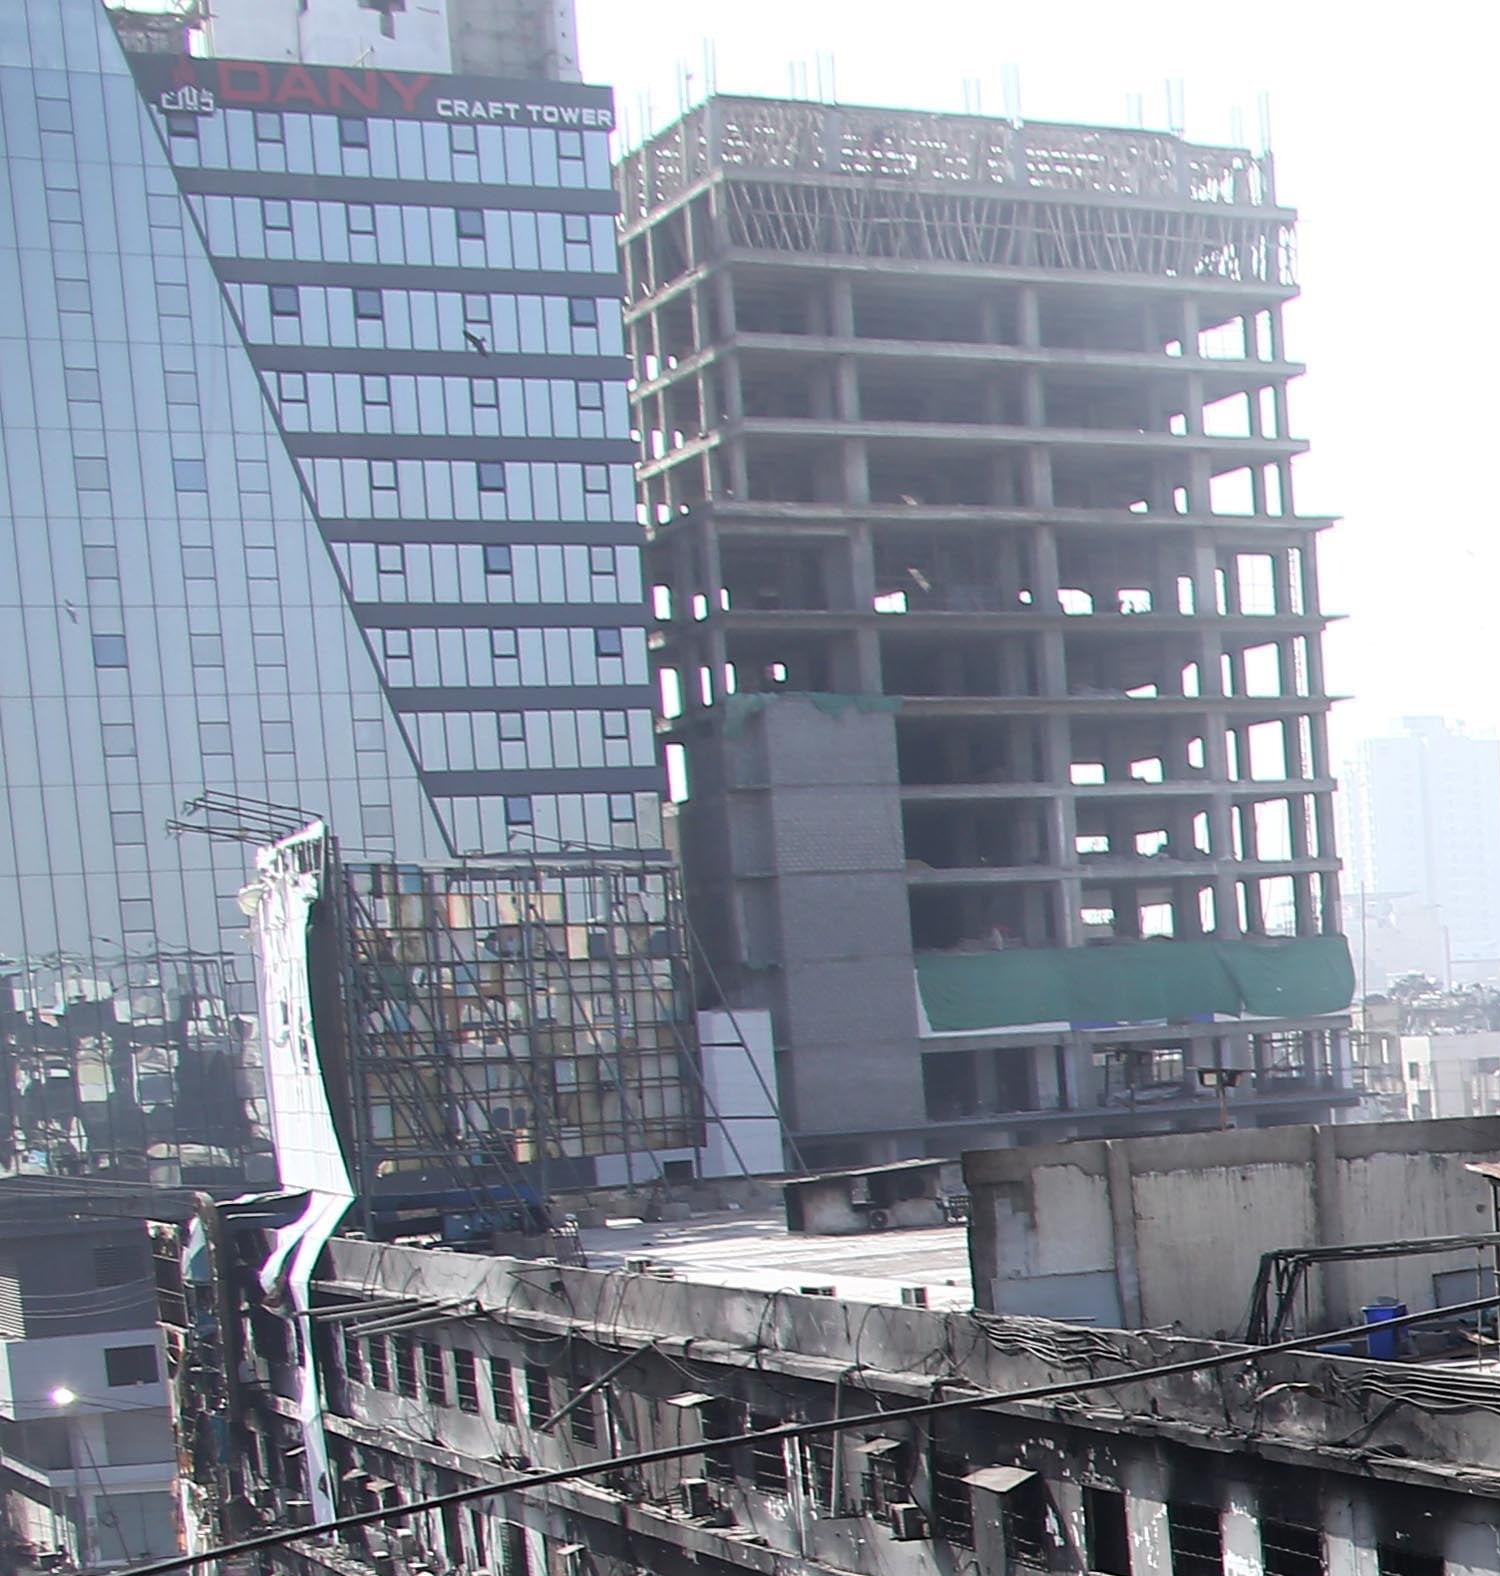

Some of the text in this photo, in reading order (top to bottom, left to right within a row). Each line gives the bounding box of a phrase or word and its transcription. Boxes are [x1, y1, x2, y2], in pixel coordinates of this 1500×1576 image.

[217, 61, 433, 112] DANY
[436, 99, 613, 127] CRAFT TOWER
